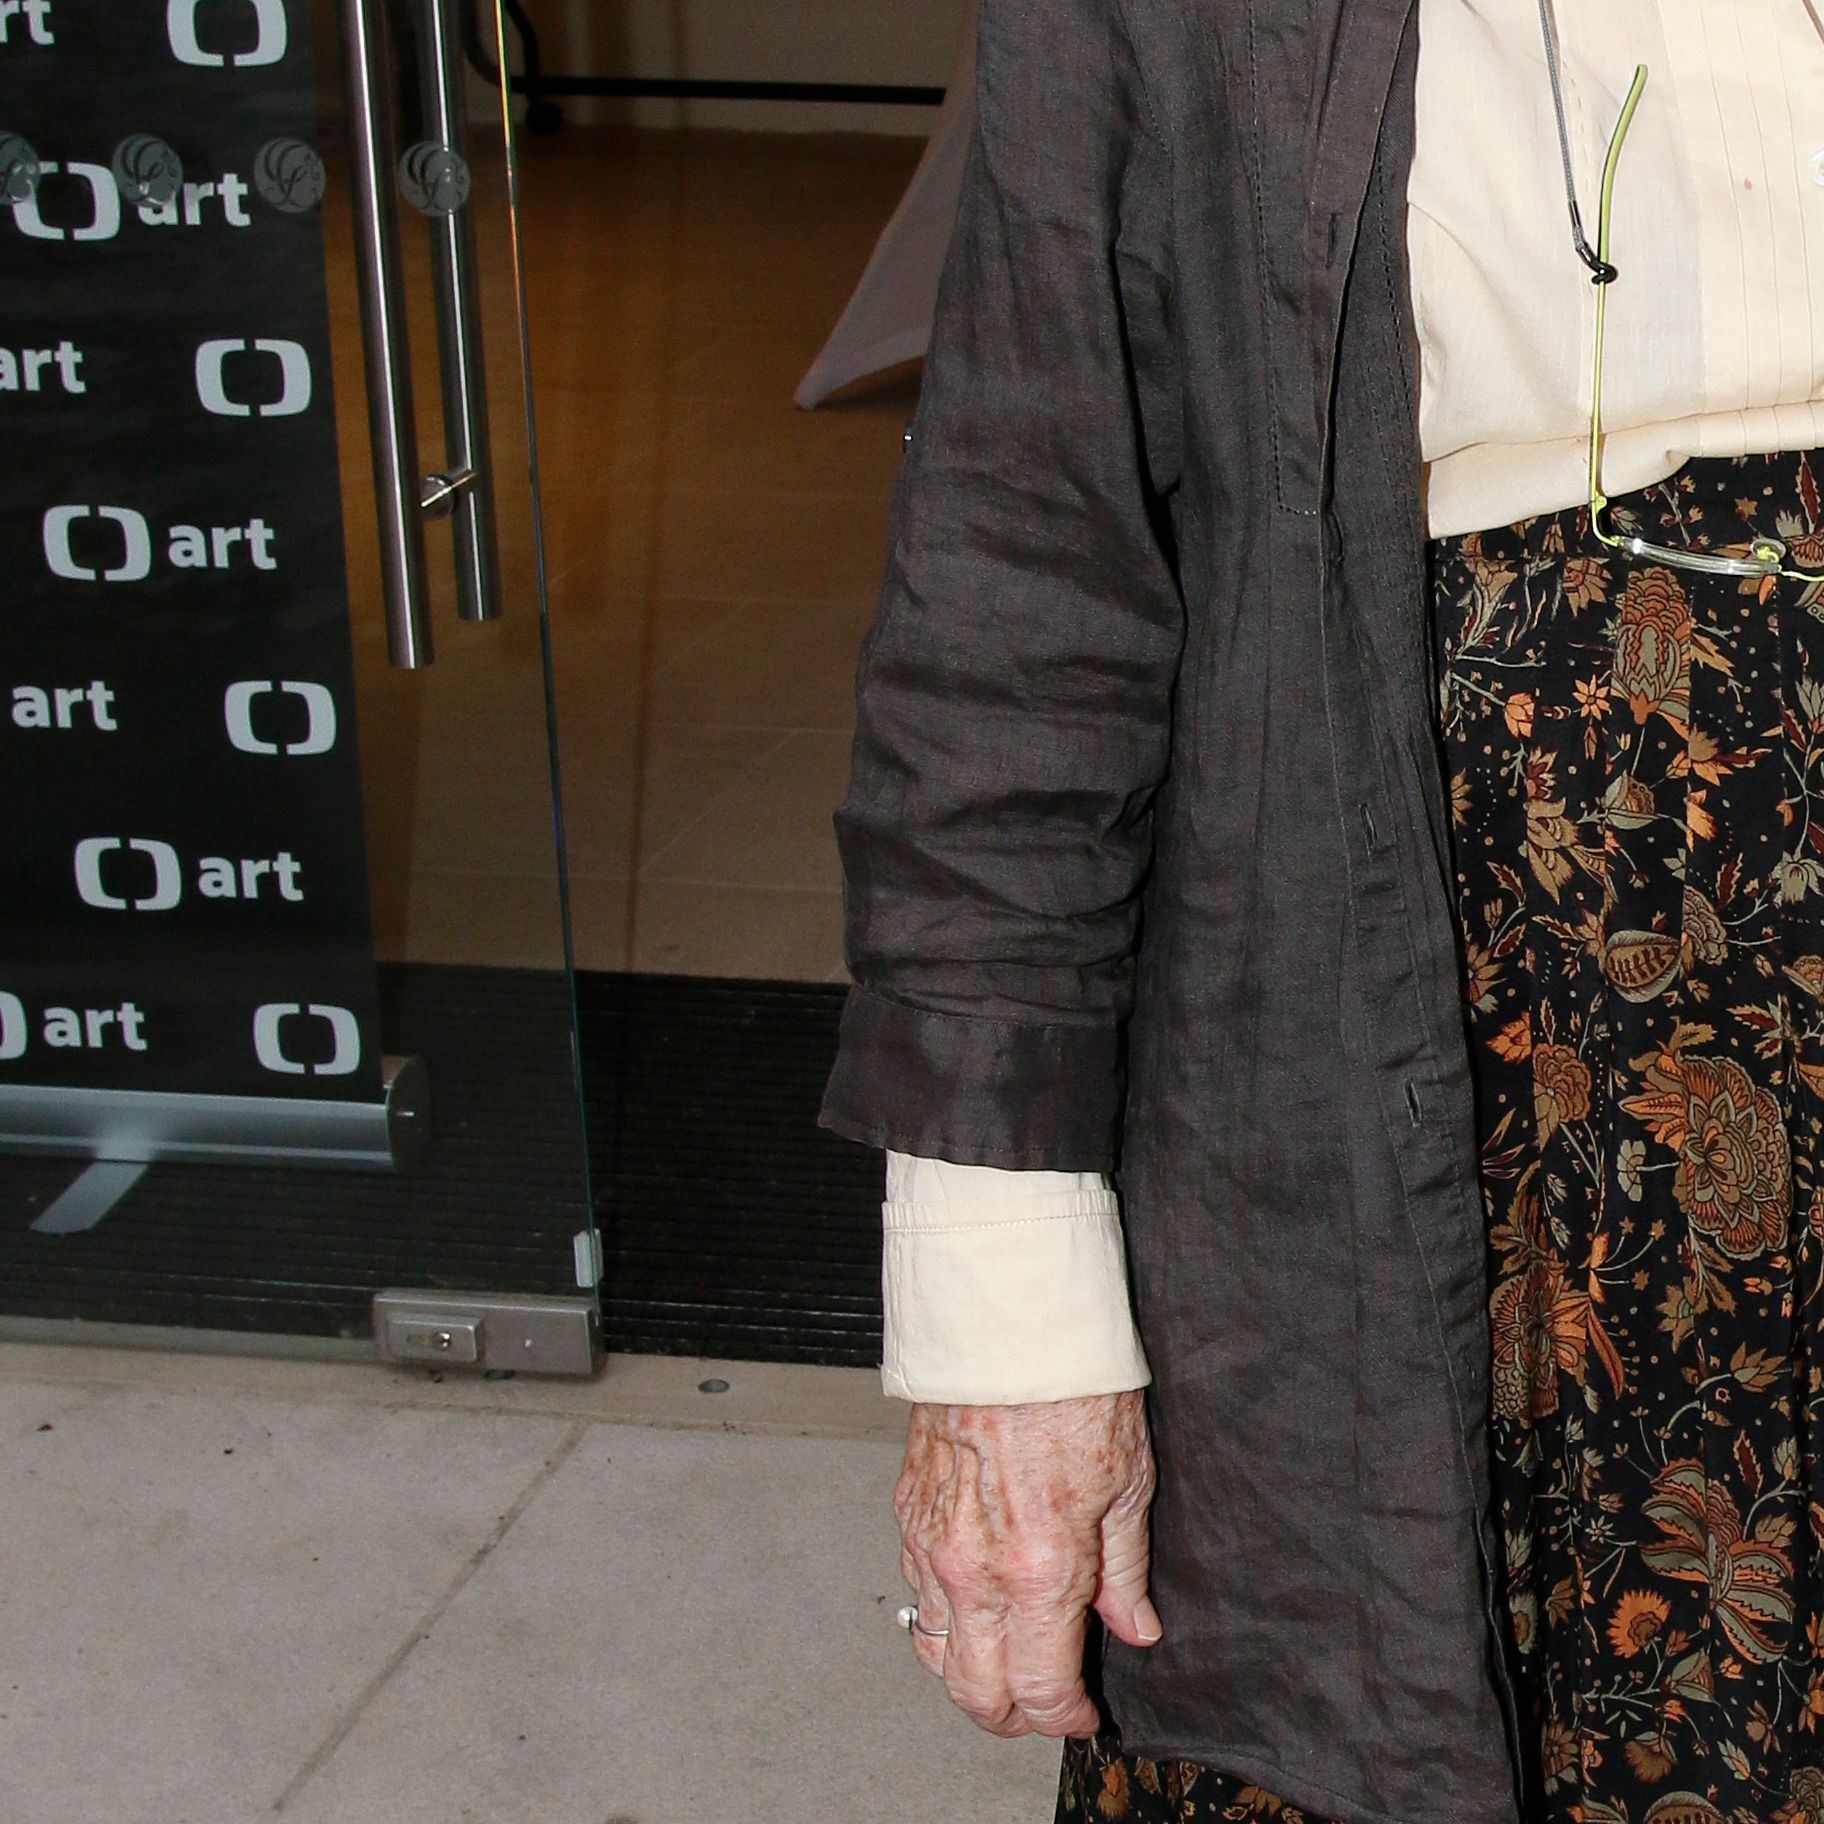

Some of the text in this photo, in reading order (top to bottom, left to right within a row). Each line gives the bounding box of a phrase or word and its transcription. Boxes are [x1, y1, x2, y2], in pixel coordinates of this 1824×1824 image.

[168, 518, 277, 570] art
[11, 680, 118, 731] art
[198, 852, 304, 902] art
[43, 1002, 148, 1051] art
